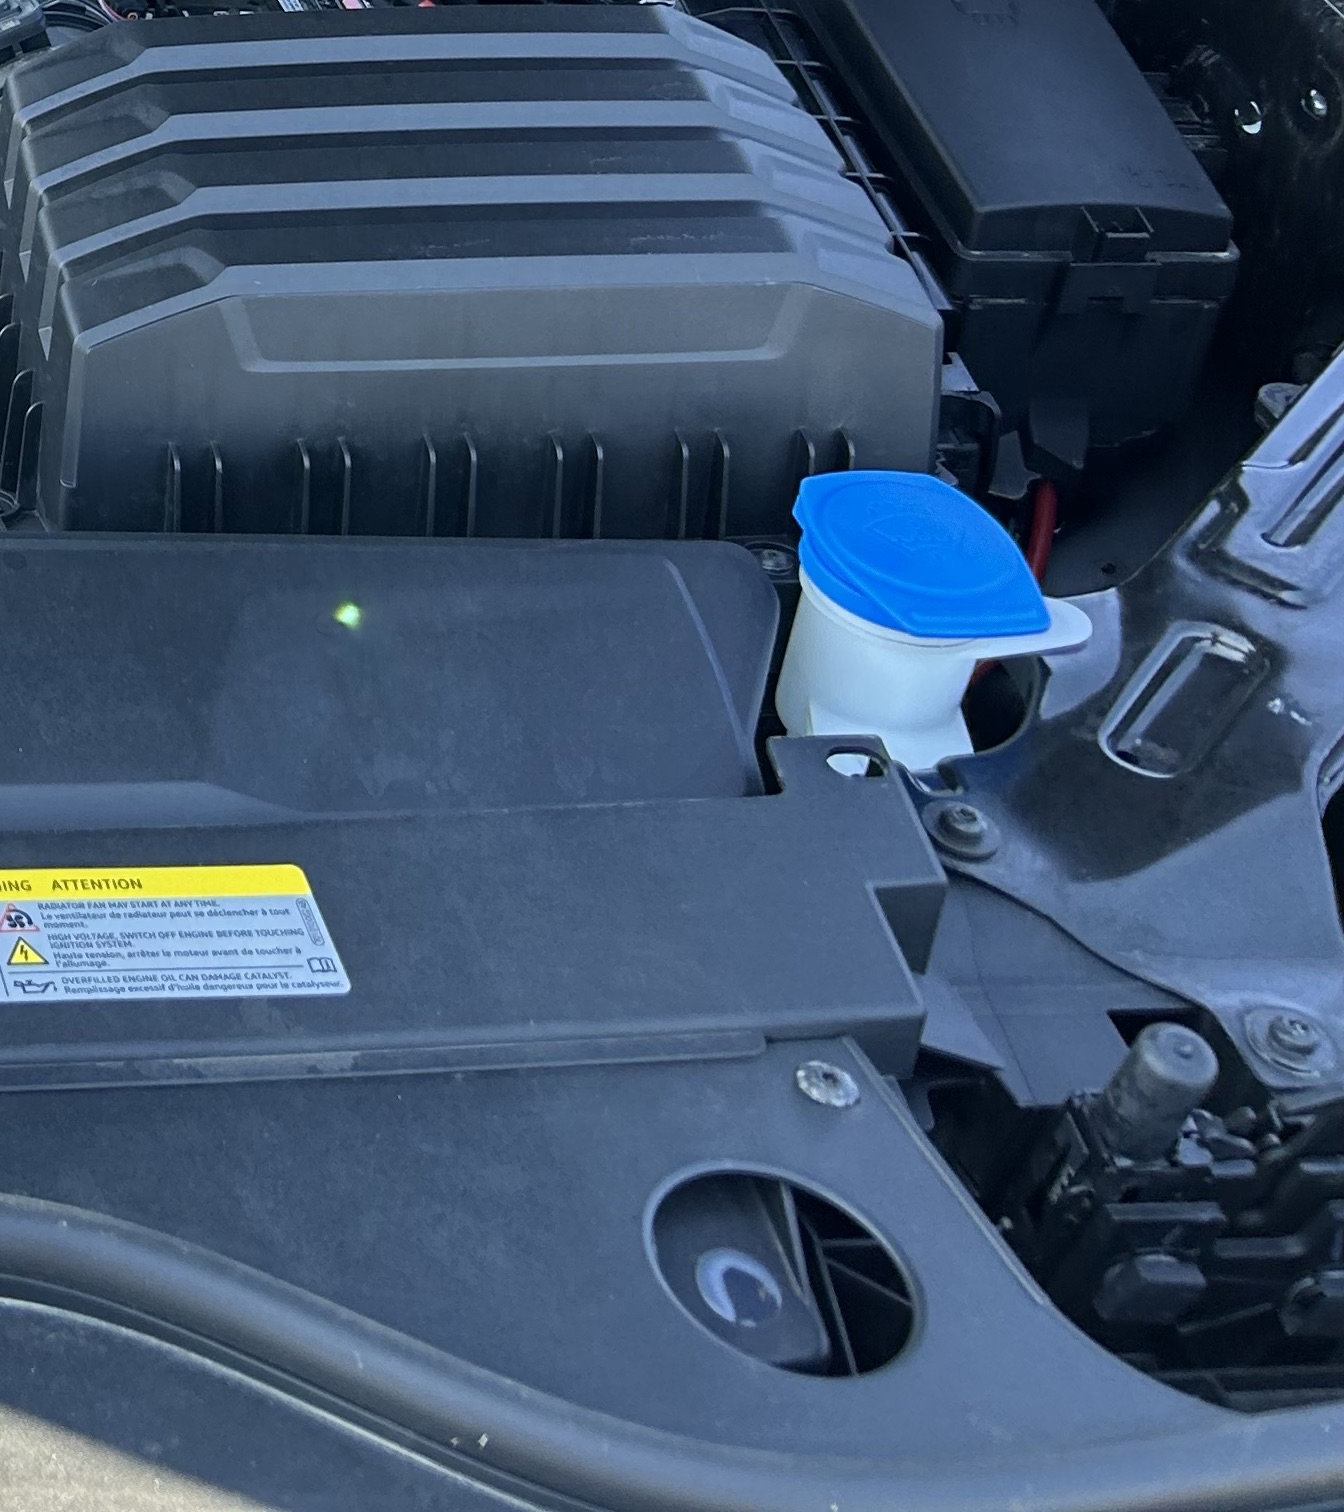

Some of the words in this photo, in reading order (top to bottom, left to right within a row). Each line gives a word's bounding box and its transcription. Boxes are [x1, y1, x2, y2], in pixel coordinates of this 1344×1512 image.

[52, 878, 143, 891] ATTENTION
[37, 901, 86, 910] RADIATOR
[87, 900, 107, 909] FAN
[108, 900, 128, 909] MAY
[130, 899, 159, 909] START
[161, 899, 173, 908] AT
[173, 899, 193, 908] ANY
[195, 899, 221, 908] TIME.
[40, 911, 54, 920] Le
[54, 910, 107, 920] ventilateur
[108, 910, 122, 919] de
[123, 909, 168, 919] radiateur
[169, 910, 193, 920] peut
[193, 910, 205, 918] se
[206, 908, 259, 917] déclencher
[269, 907, 290, 916] tout
[43, 920, 88, 930] moment.
[47, 933, 72, 941] HIGH
[119, 931, 156, 939] SWITCH
[157, 931, 177, 939] OFF
[178, 930, 214, 939] ENGINE
[215, 929, 254, 938] BEFORE
[254, 928, 305, 937] TOUCHING
[50, 941, 94, 949] IGNITION
[95, 940, 135, 949] SYSTEM.
[53, 951, 83, 960] Haute
[84, 951, 126, 960] tension,
[173, 949, 209, 957] moteur
[211, 948, 240, 956] avant
[240, 947, 254, 956] de
[254, 947, 293, 956] toucher
[61, 975, 121, 984] OVERFILLED
[122, 974, 159, 983] ENGINE
[160, 973, 178, 982] OIL
[178, 973, 199, 982] CAN
[200, 972, 242, 981] DAMAGE
[243, 971, 293, 980] CATALYST.
[64, 985, 126, 995] Remplissage
[127, 983, 167, 993] excessif
[202, 982, 255, 993] dangereux
[255, 982, 278, 992] pour
[278, 981, 289, 989] le
